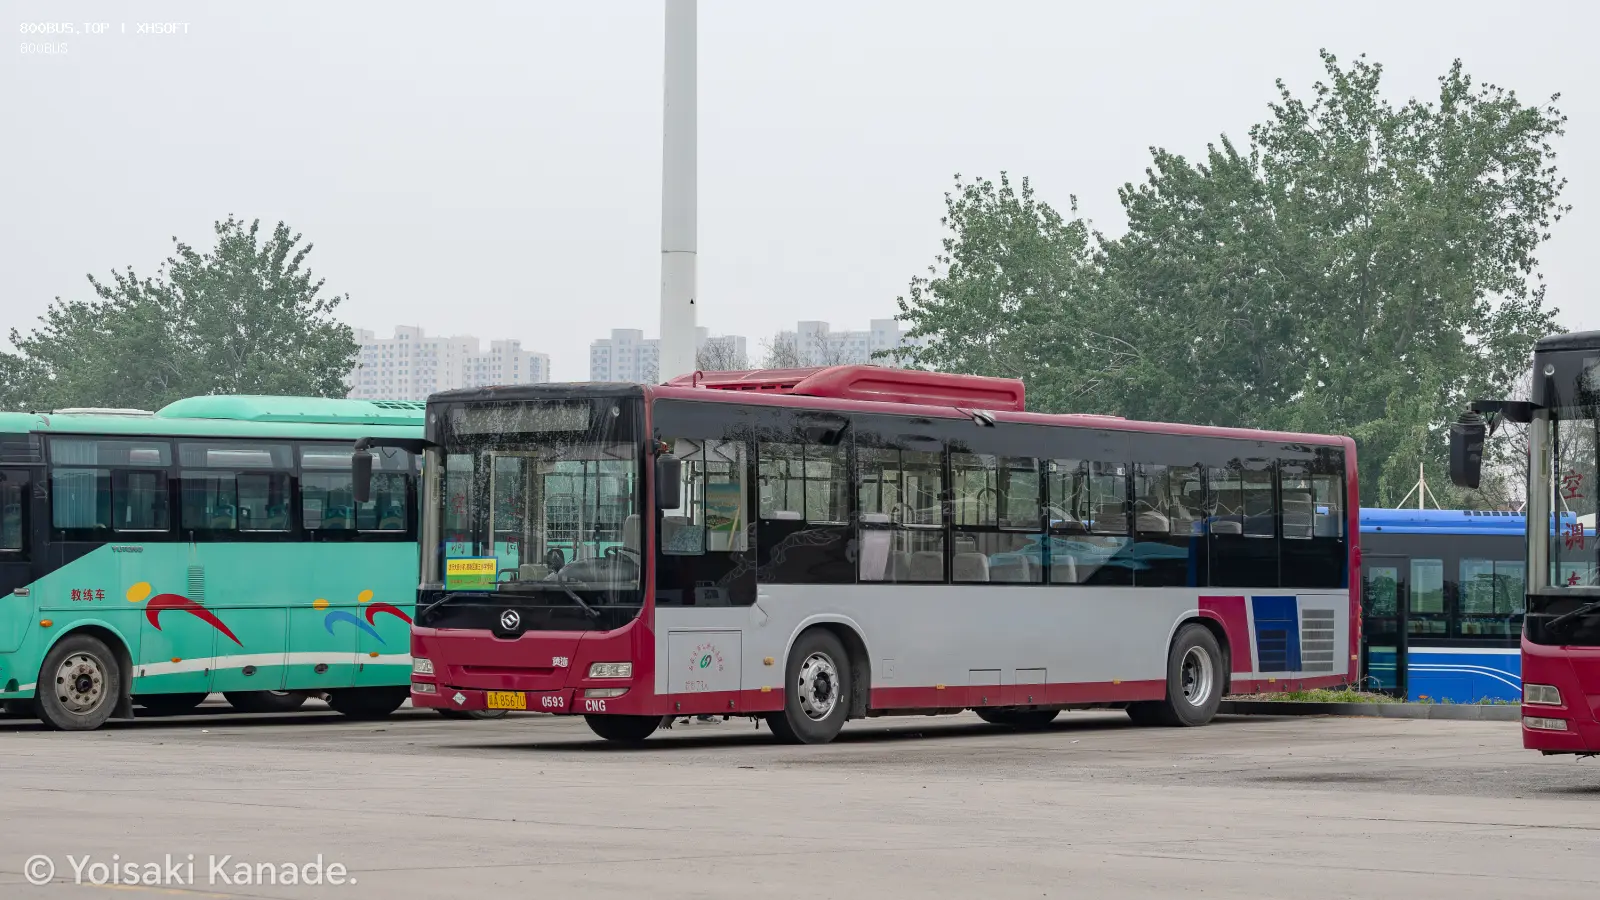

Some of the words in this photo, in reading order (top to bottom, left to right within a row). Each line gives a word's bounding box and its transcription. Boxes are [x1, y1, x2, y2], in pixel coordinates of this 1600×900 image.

[71, 588, 105, 602] 教练车
[541, 696, 564, 708] 0593
[585, 699, 607, 712] CNG
